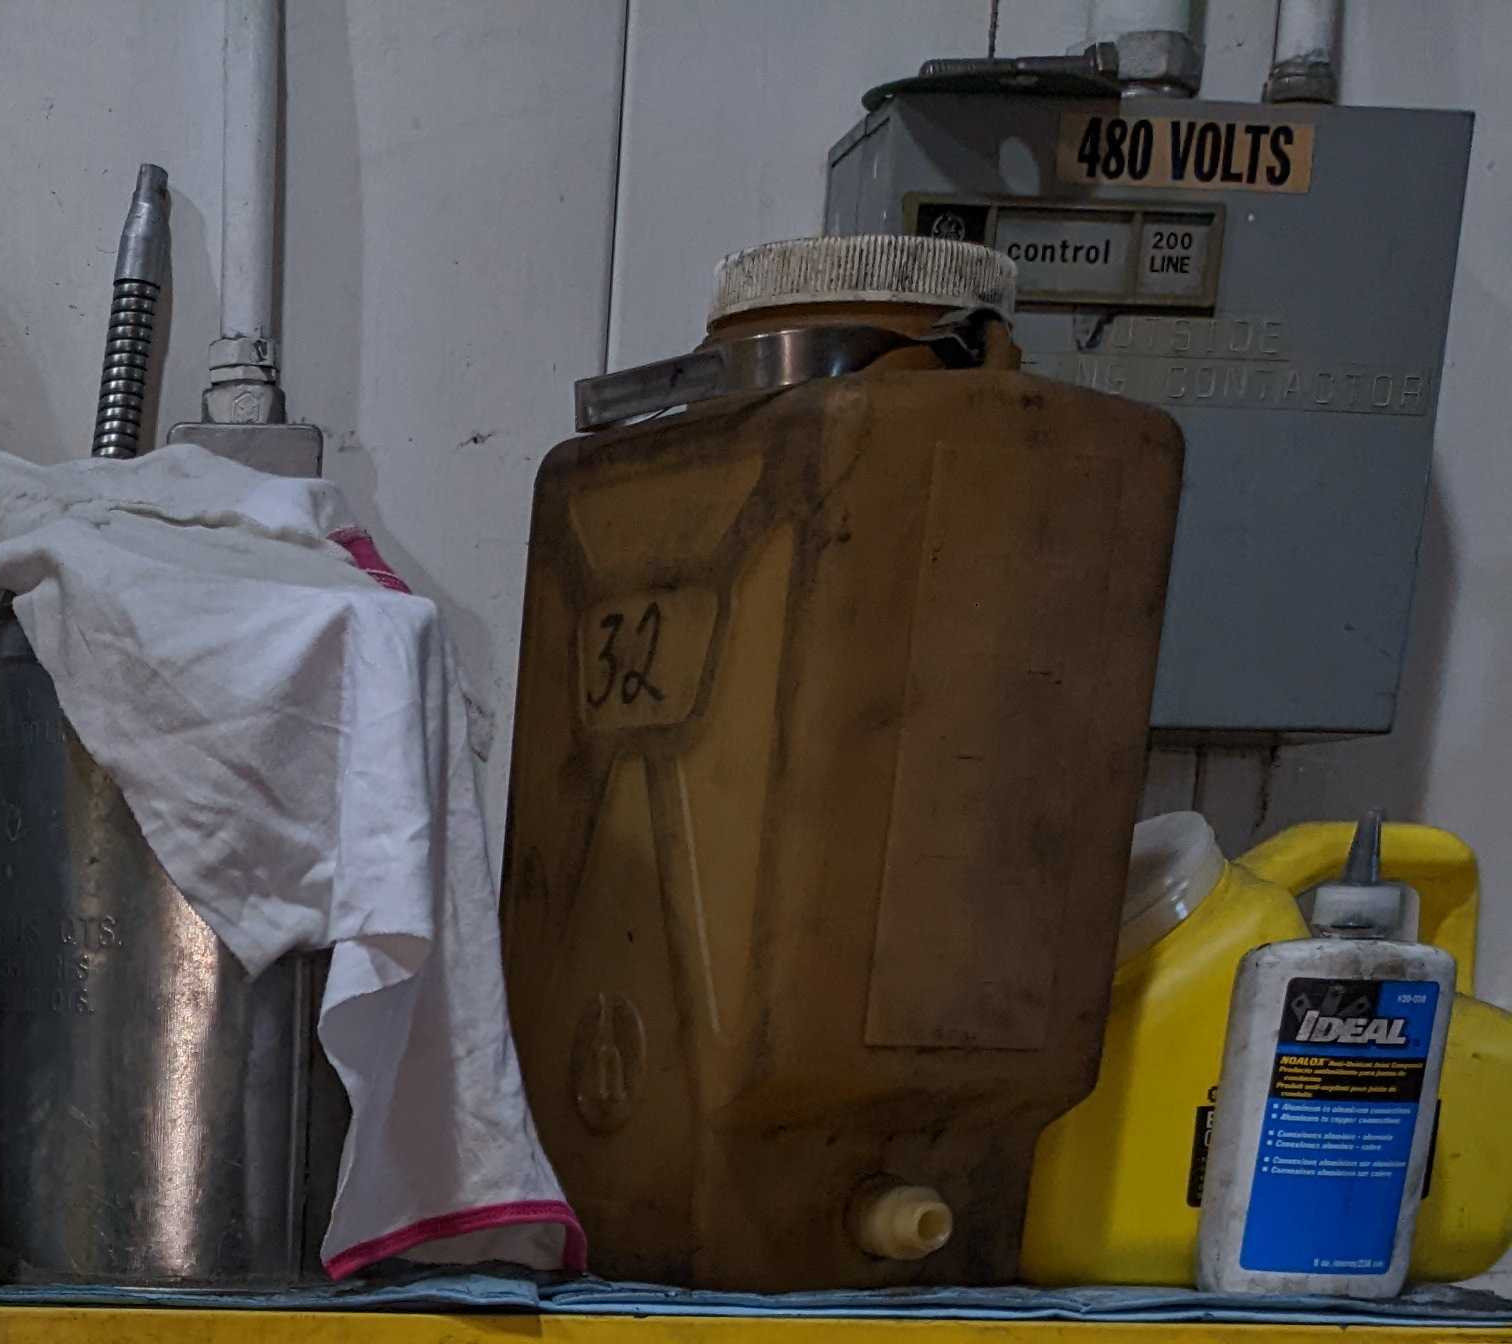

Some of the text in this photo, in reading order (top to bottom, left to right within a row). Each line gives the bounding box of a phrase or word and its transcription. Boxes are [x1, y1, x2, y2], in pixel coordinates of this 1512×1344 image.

[1078, 116, 1295, 186] 480 VOLTS
[1007, 239, 1112, 265] control
[1151, 231, 1193, 250] 200
[1149, 255, 1192, 274] LINE
[1110, 317, 1283, 355] UTSIDE
[587, 601, 666, 709] 32
[1295, 1009, 1407, 1045] IDEAL
